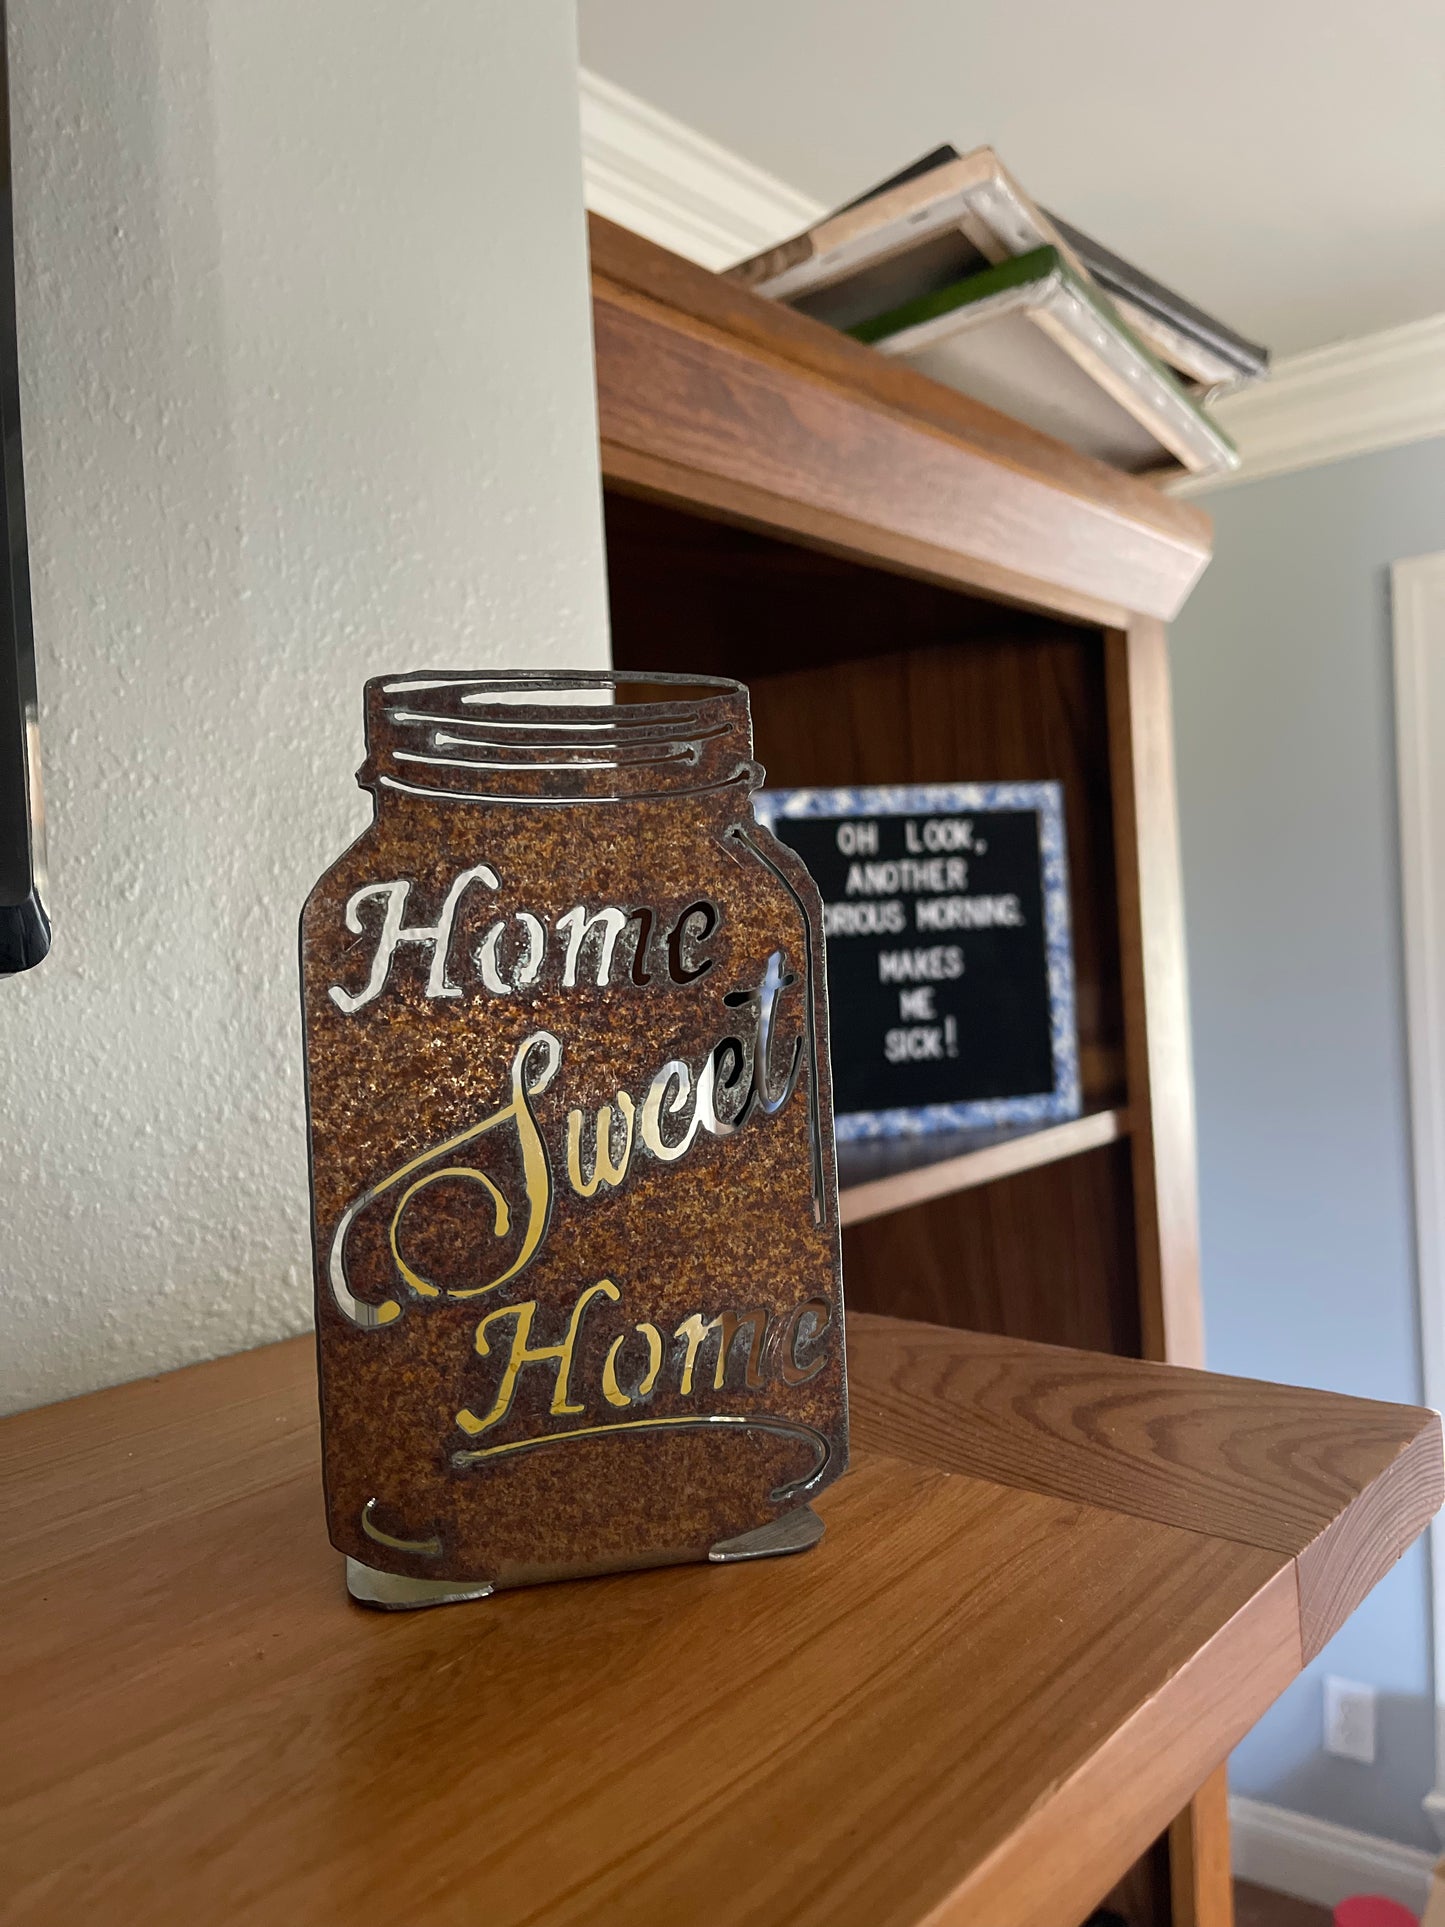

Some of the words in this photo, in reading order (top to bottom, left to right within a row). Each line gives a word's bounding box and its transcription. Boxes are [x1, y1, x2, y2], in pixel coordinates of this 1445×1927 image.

[837, 823, 880, 855] OH
[846, 858, 968, 894] ANOTHER
[328, 865, 720, 1014] Home
[879, 947, 964, 983] MAKES
[900, 987, 936, 1020] ME
[885, 1015, 958, 1063] SICK!
[328, 949, 803, 1326] Sweet
[454, 1279, 833, 1437] Home
